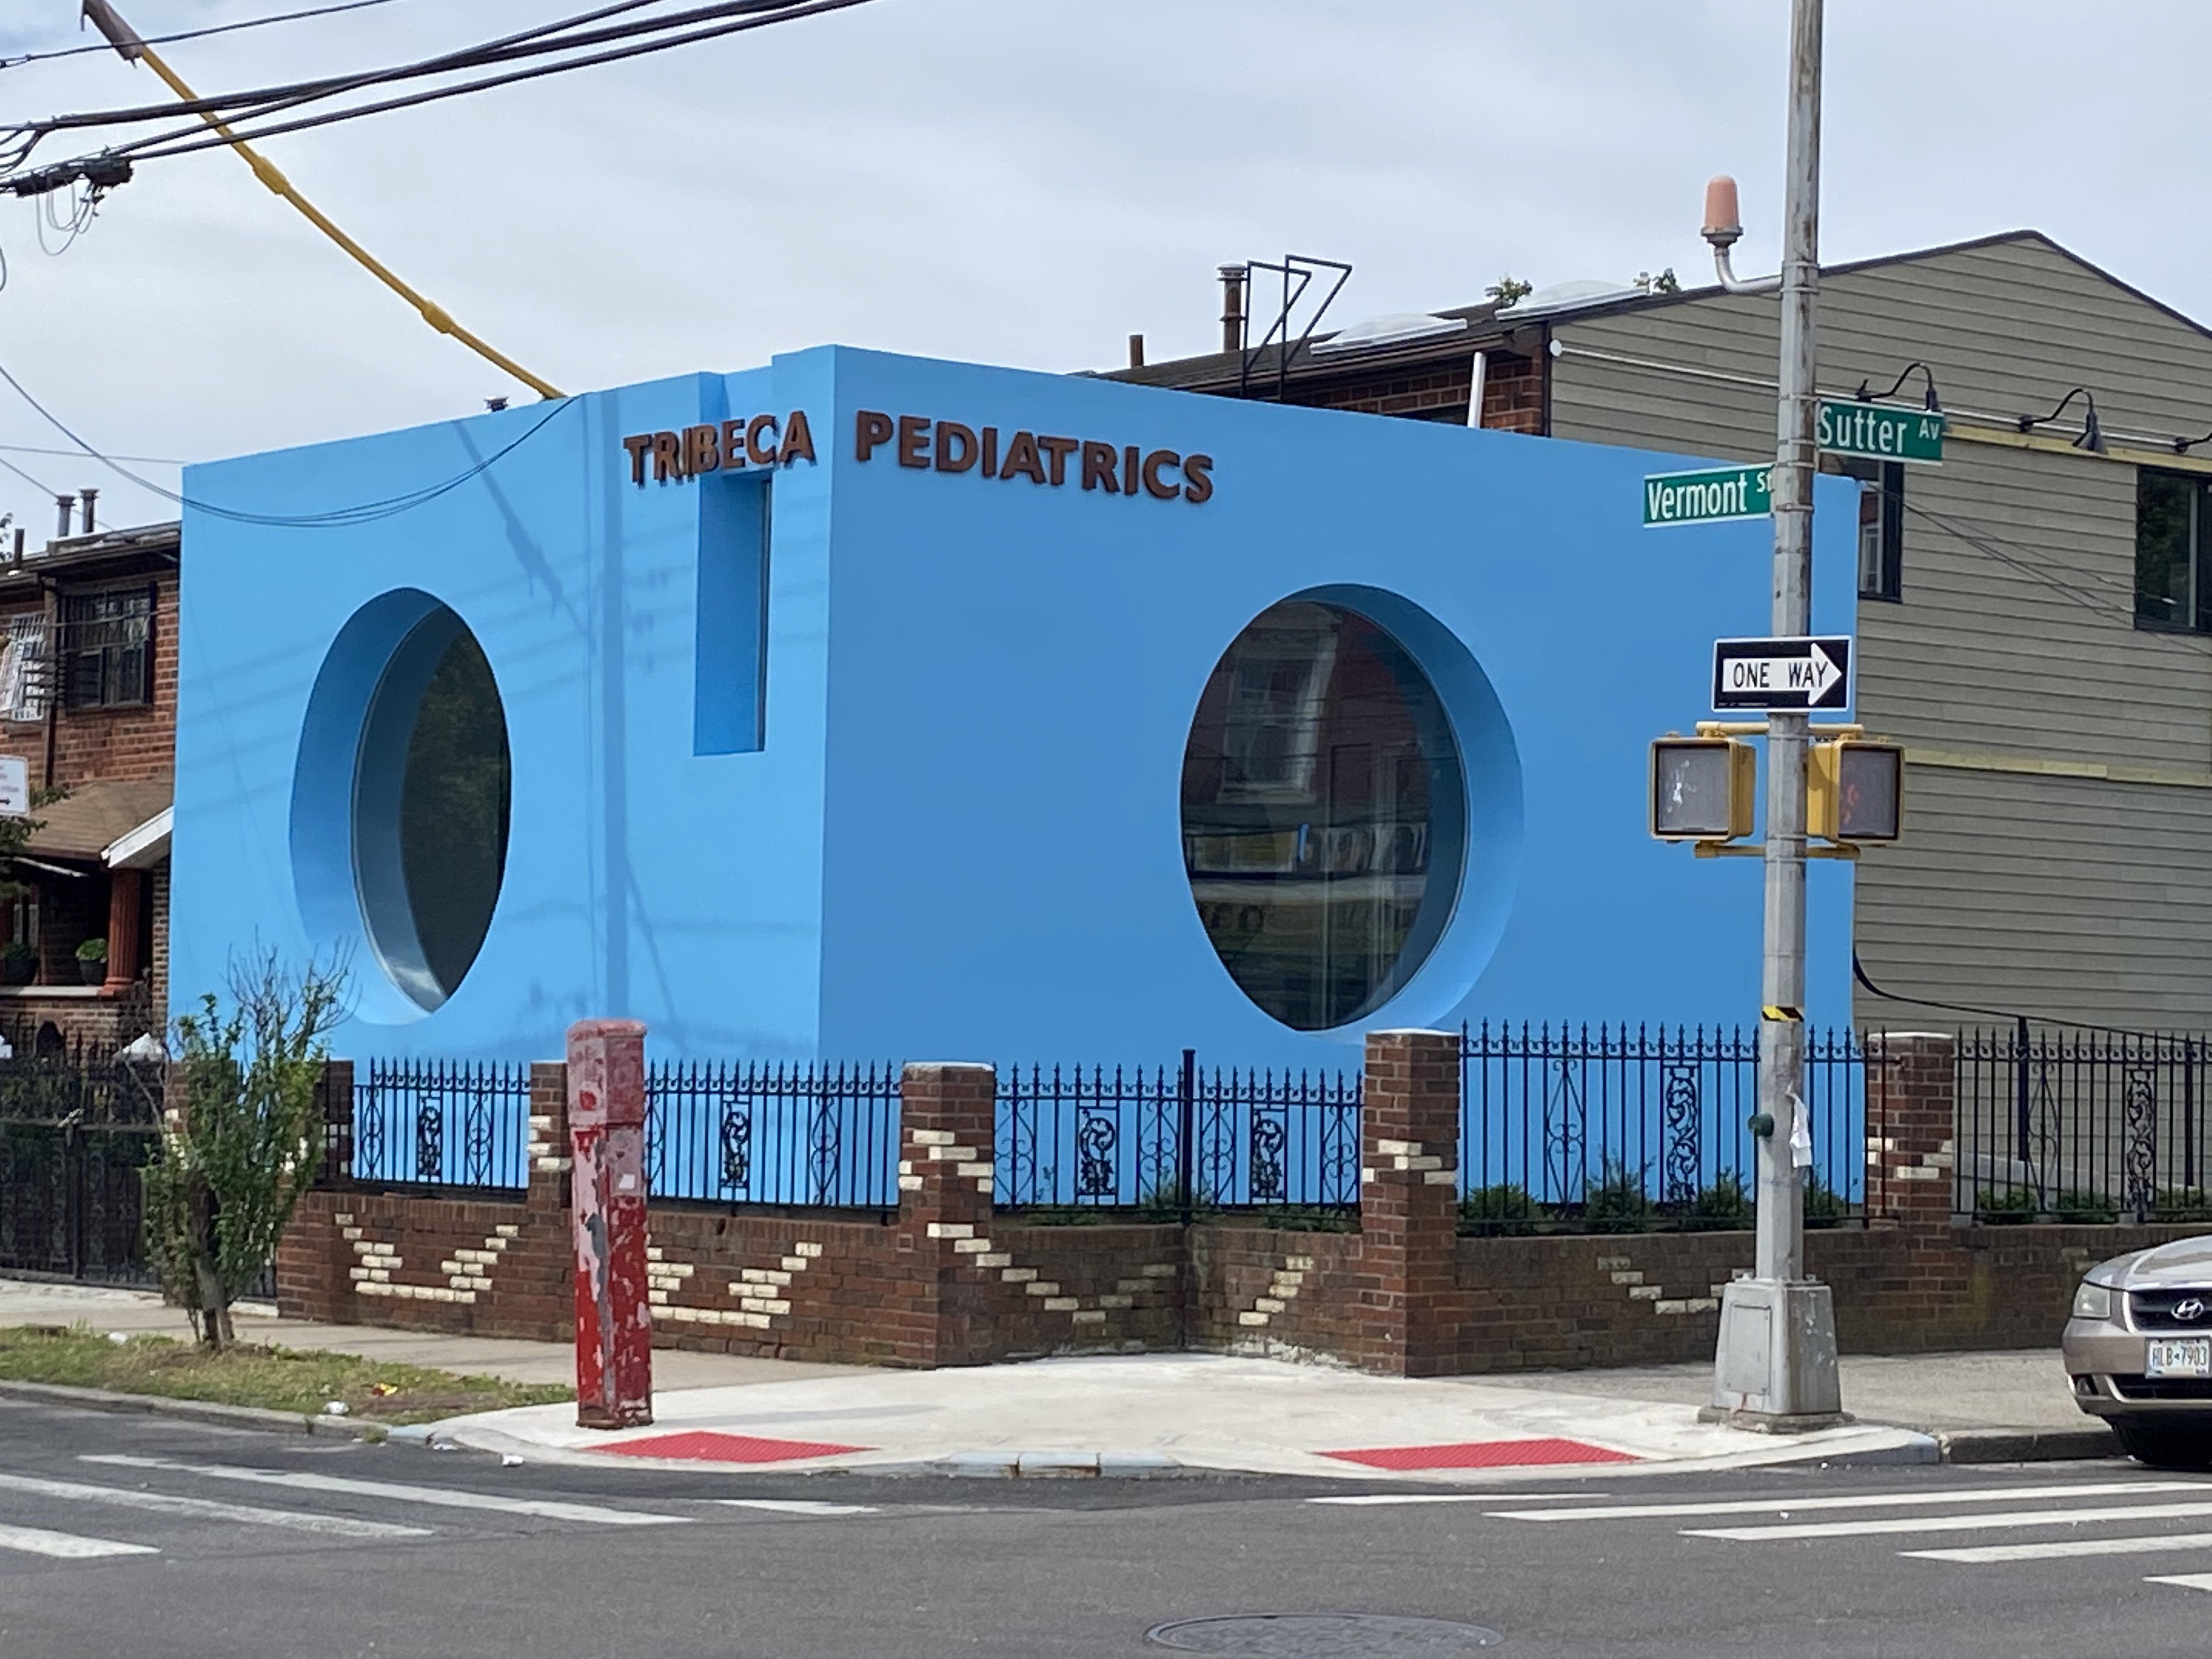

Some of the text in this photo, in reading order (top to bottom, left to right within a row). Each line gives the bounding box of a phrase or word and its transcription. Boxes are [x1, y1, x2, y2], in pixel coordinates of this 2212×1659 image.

[1819, 405, 1940, 454] Sutter Av
[623, 410, 1215, 504] TRIBECA PEDIATRICS
[1647, 471, 1773, 520] Vermont St
[1733, 661, 1829, 689] ONE WAY
